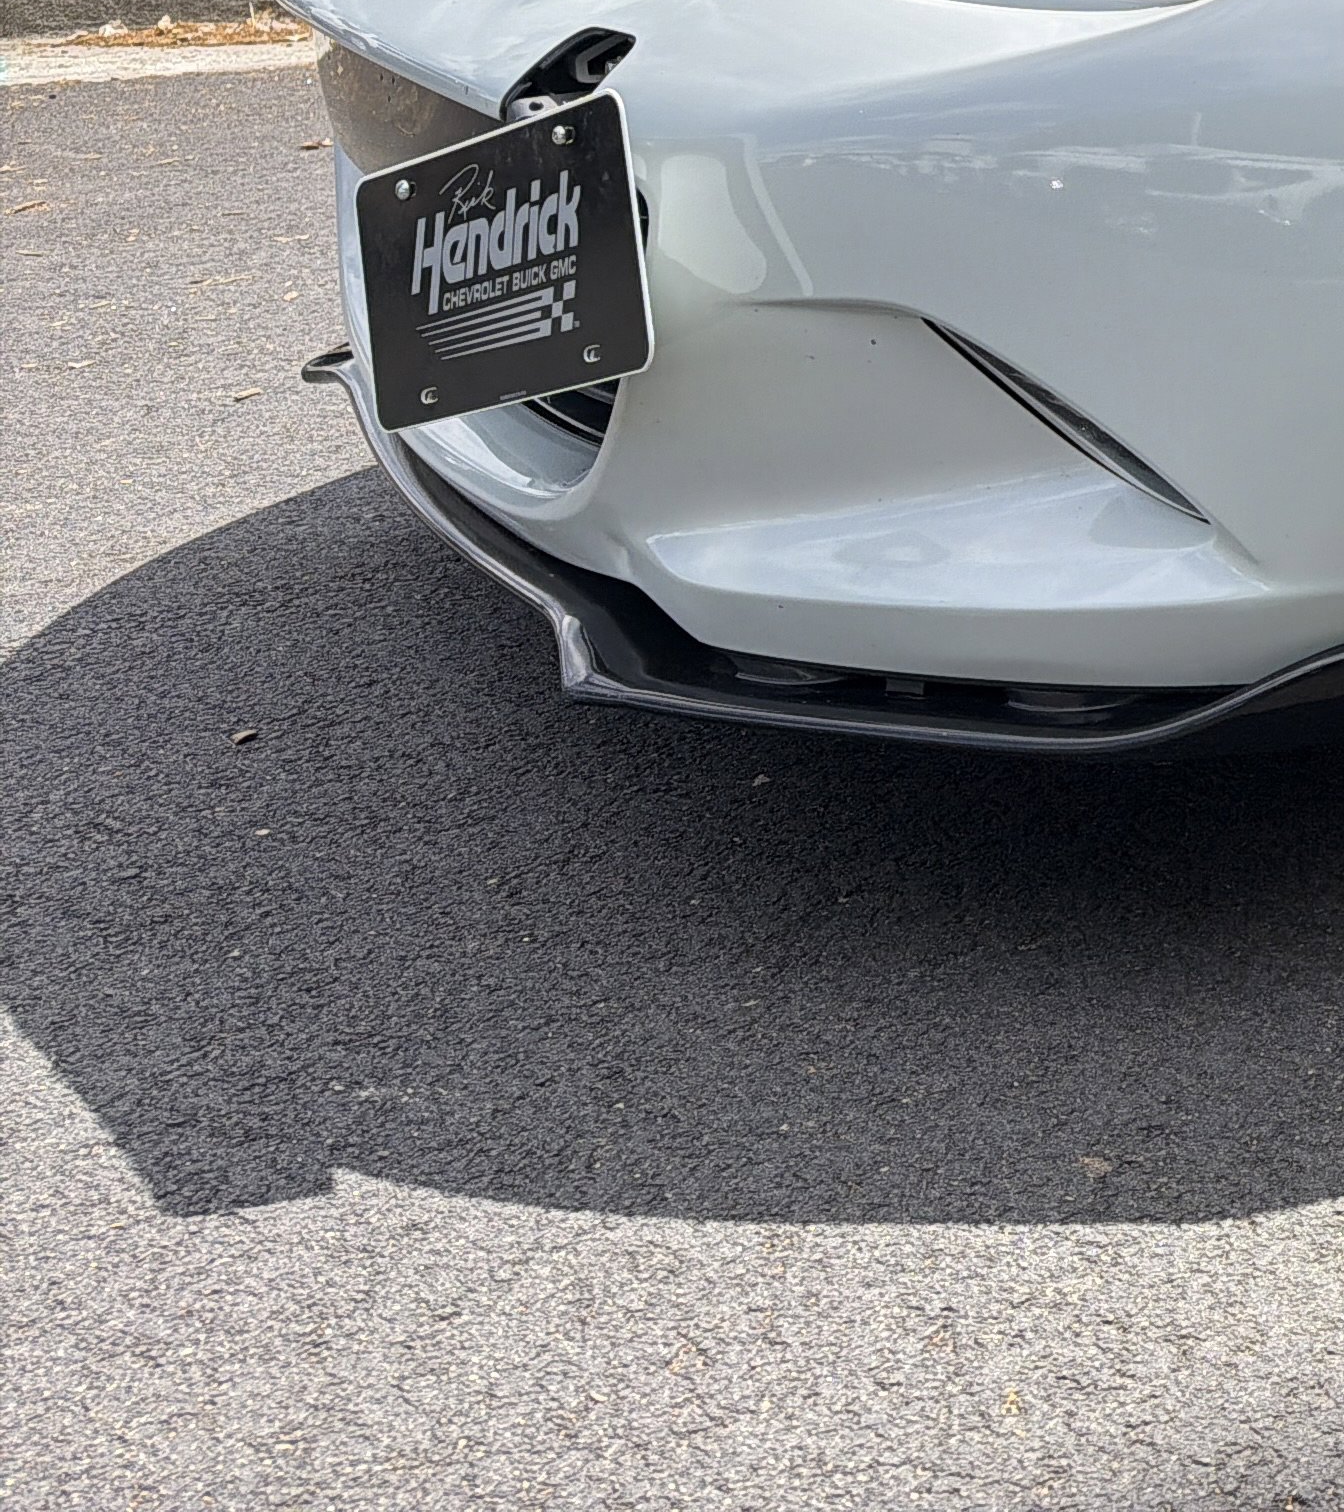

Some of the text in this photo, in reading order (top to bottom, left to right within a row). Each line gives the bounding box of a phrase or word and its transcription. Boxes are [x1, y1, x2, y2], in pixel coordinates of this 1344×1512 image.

[411, 169, 582, 316] Hendrick
[442, 254, 577, 312] CHEVROLET BUICK GMC
